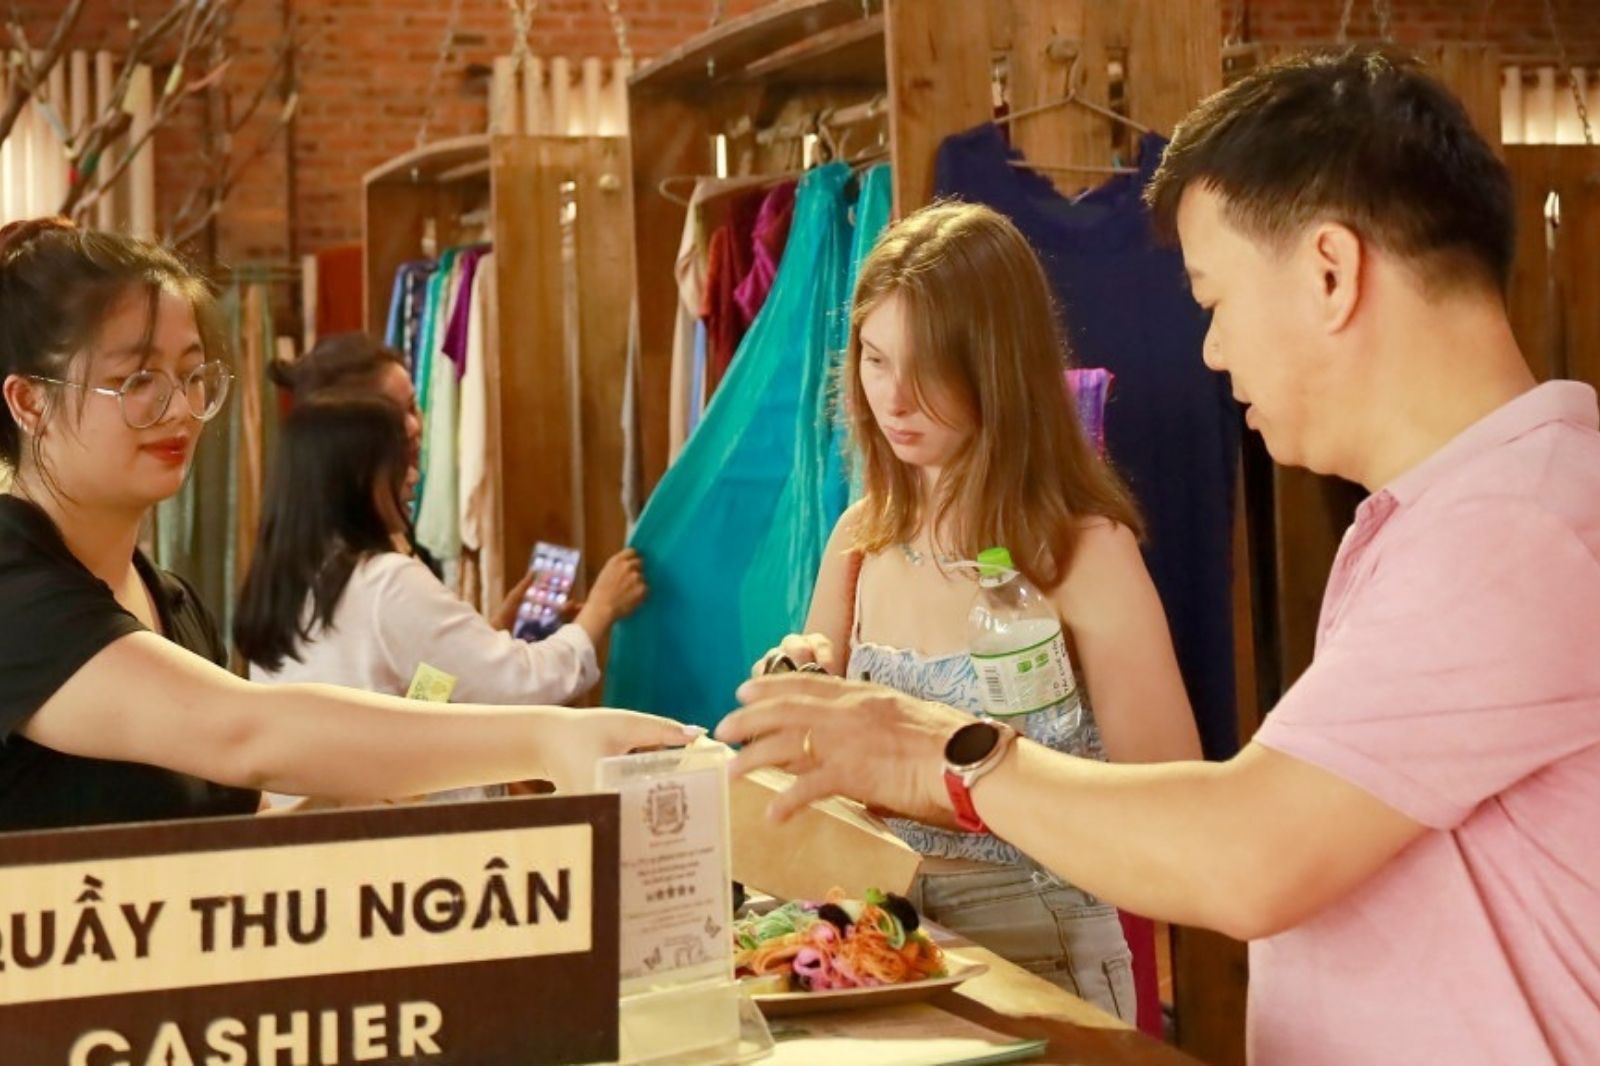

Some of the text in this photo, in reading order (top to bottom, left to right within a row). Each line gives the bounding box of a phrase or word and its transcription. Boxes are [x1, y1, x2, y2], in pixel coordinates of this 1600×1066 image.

[0, 857, 570, 972] UẦY THU NGÂN
[69, 1002, 443, 1066] CASHIER
